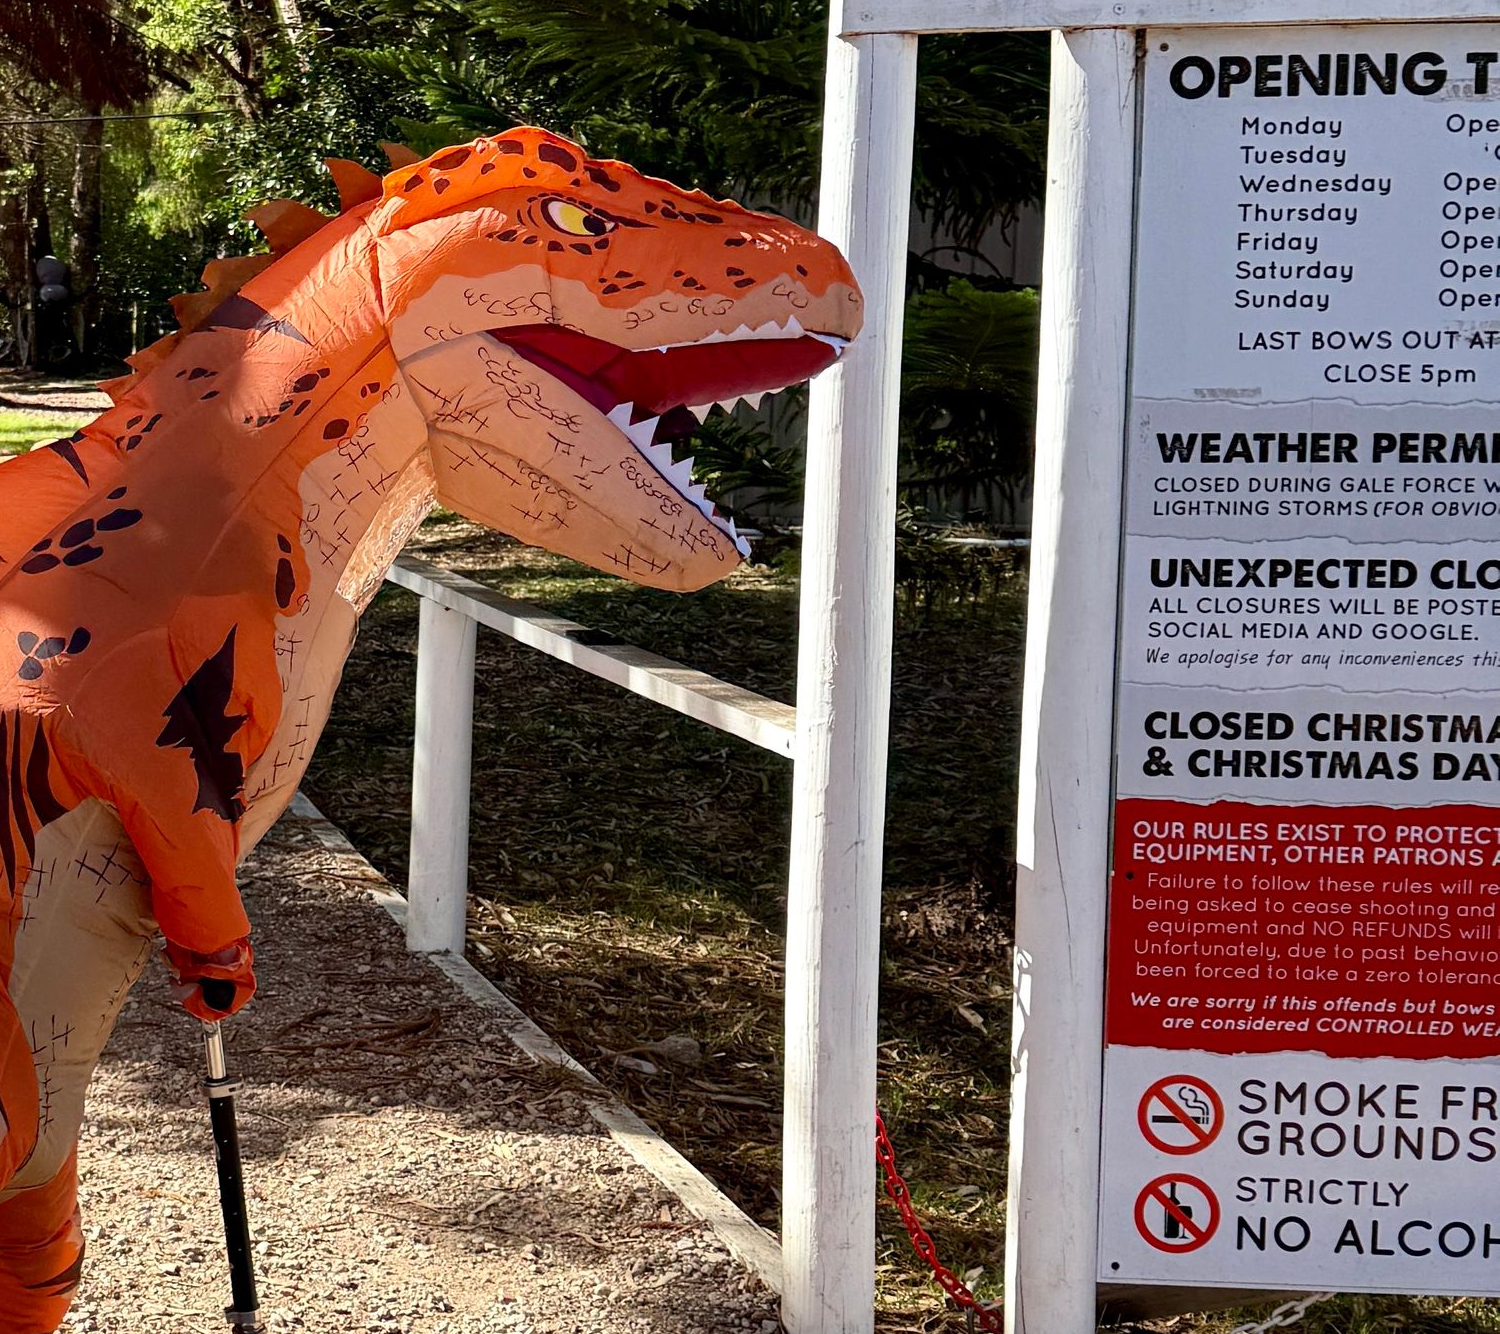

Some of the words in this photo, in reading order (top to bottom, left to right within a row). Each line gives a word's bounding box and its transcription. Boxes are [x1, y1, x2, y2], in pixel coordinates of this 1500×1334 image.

[1168, 51, 1449, 100] OPENING
[1241, 115, 1343, 139] Monday
[1239, 144, 1347, 168] Tuesday
[1239, 173, 1392, 196] Wednesday
[1237, 202, 1358, 226] Thursday
[1441, 200, 1500, 226] Ope
[1237, 231, 1319, 255] Friday
[1235, 260, 1354, 284] Saturday
[1234, 289, 1330, 313] Sunday
[1238, 330, 1302, 351] LAST
[1311, 330, 1393, 351] BOWS
[1401, 330, 1459, 351] OUT
[1468, 330, 1500, 351] AT
[1323, 363, 1412, 384] CLOSE
[1420, 363, 1476, 388] 5pm
[1155, 432, 1359, 464] WEATHER
[1153, 476, 1240, 493] CLOSED
[1248, 476, 1331, 494] DURING
[1339, 476, 1396, 494] GALE
[1402, 476, 1476, 494] FORCE
[1153, 499, 1270, 516] LIGHTNING
[1277, 500, 1368, 517] STORMS
[1373, 500, 1424, 518] (FOR
[1431, 500, 1500, 517] OBVIO
[1150, 558, 1418, 590] UNEXPECTED
[1148, 597, 1189, 614] ALL
[1196, 596, 1321, 615] CLOSURES
[1328, 598, 1386, 616] WILL
[1392, 598, 1420, 616] BE
[1147, 621, 1234, 639] SOCIAL
[1241, 622, 1310, 640] MEDIA
[1315, 622, 1363, 640] AND
[1371, 622, 1479, 641] GOOGLE.
[1146, 646, 1170, 664] We
[1177, 648, 1259, 670] apologise
[1266, 648, 1294, 667] for
[1300, 653, 1331, 670] any
[1338, 649, 1465, 667] inconveniences
[1143, 710, 1295, 741] CLOSED
[1142, 745, 1175, 778] &
[1187, 748, 1420, 781] CHRISTMAS
[1284, 844, 1365, 864] OTHER
[1373, 846, 1484, 867] PATRONS
[1130, 991, 1161, 1007] We
[1166, 996, 1200, 1008] are
[1205, 997, 1256, 1013] sorry
[1262, 995, 1278, 1010] if
[1282, 995, 1318, 1011] this
[1323, 996, 1397, 1013] offends
[1402, 998, 1437, 1014] but
[1442, 999, 1496, 1016] bows
[1237, 1078, 1420, 1120] SMOKE
[1236, 1119, 1497, 1163] GROUNDS
[1235, 1176, 1410, 1208] STRICTLY
[1236, 1215, 1312, 1253] NO
